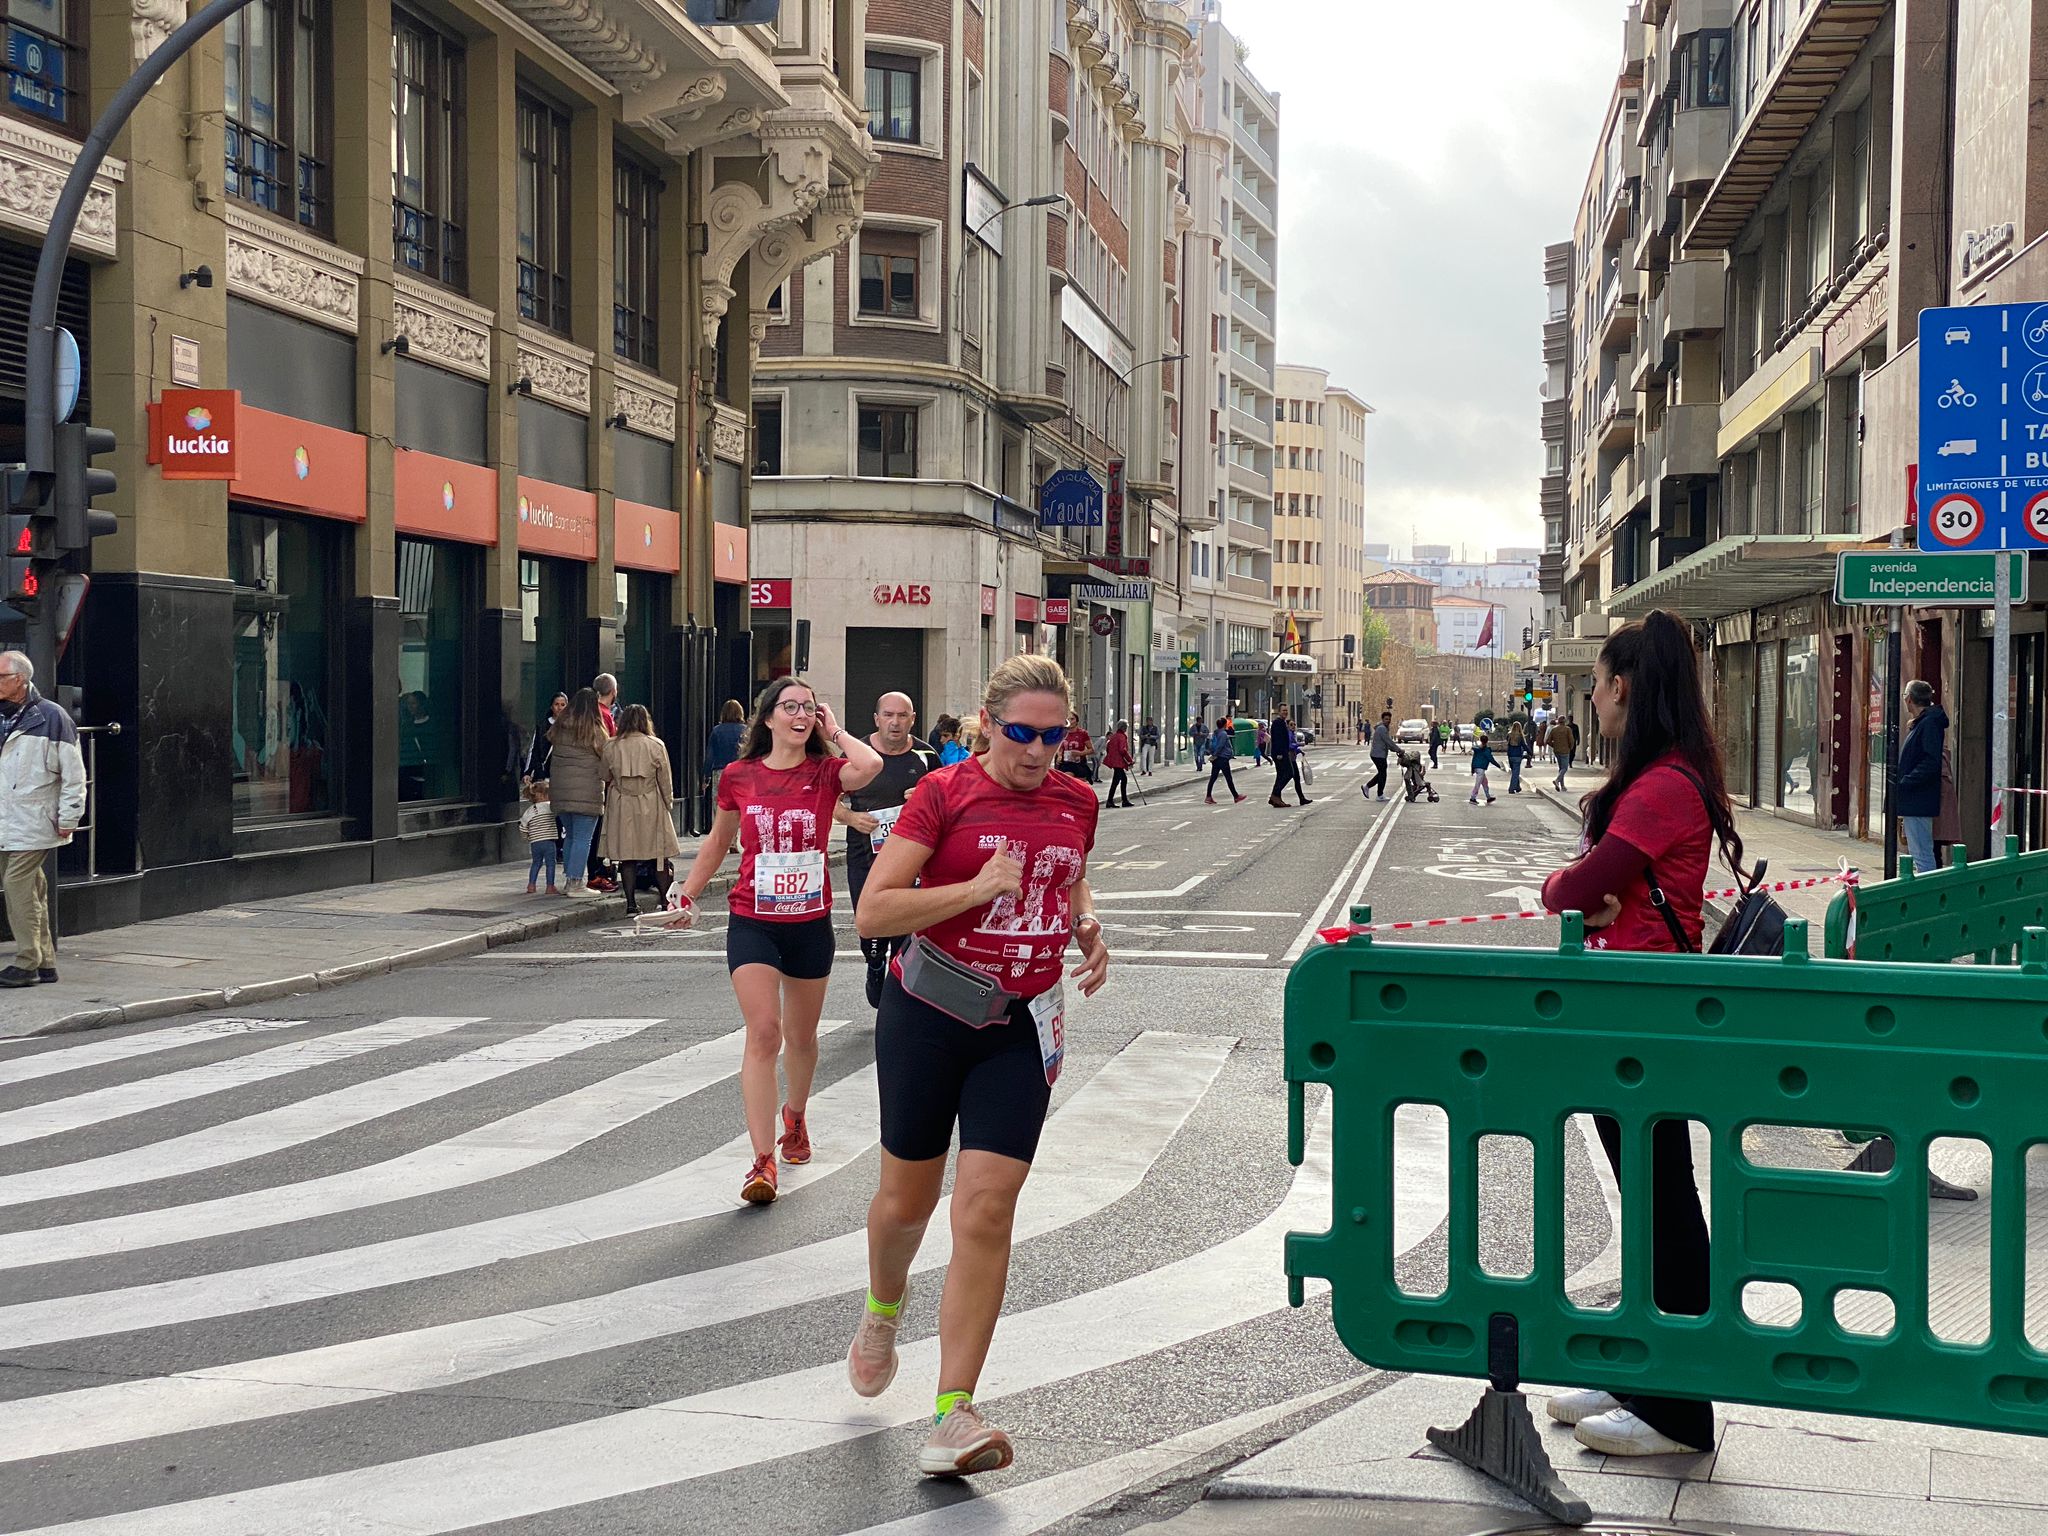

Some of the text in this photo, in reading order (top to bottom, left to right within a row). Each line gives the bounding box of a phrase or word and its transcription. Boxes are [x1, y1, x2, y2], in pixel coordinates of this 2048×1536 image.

[168, 435, 230, 454] luckia
[1927, 481, 1999, 491] LIMITACIONES
[2005, 480, 2018, 488] DE
[529, 501, 553, 528] luckia
[1107, 462, 1123, 555] FINCAS
[1941, 511, 1972, 529] 30
[1080, 559, 1150, 575] MILIO
[1870, 562, 1917, 573] avenida
[873, 584, 931, 605] GAES
[1079, 583, 1149, 600] INMOBILIARIA
[1869, 577, 1994, 597] Independencia
[1046, 605, 1068, 613] GAES
[1229, 663, 1263, 671] HOTEL
[774, 872, 808, 895] 682
